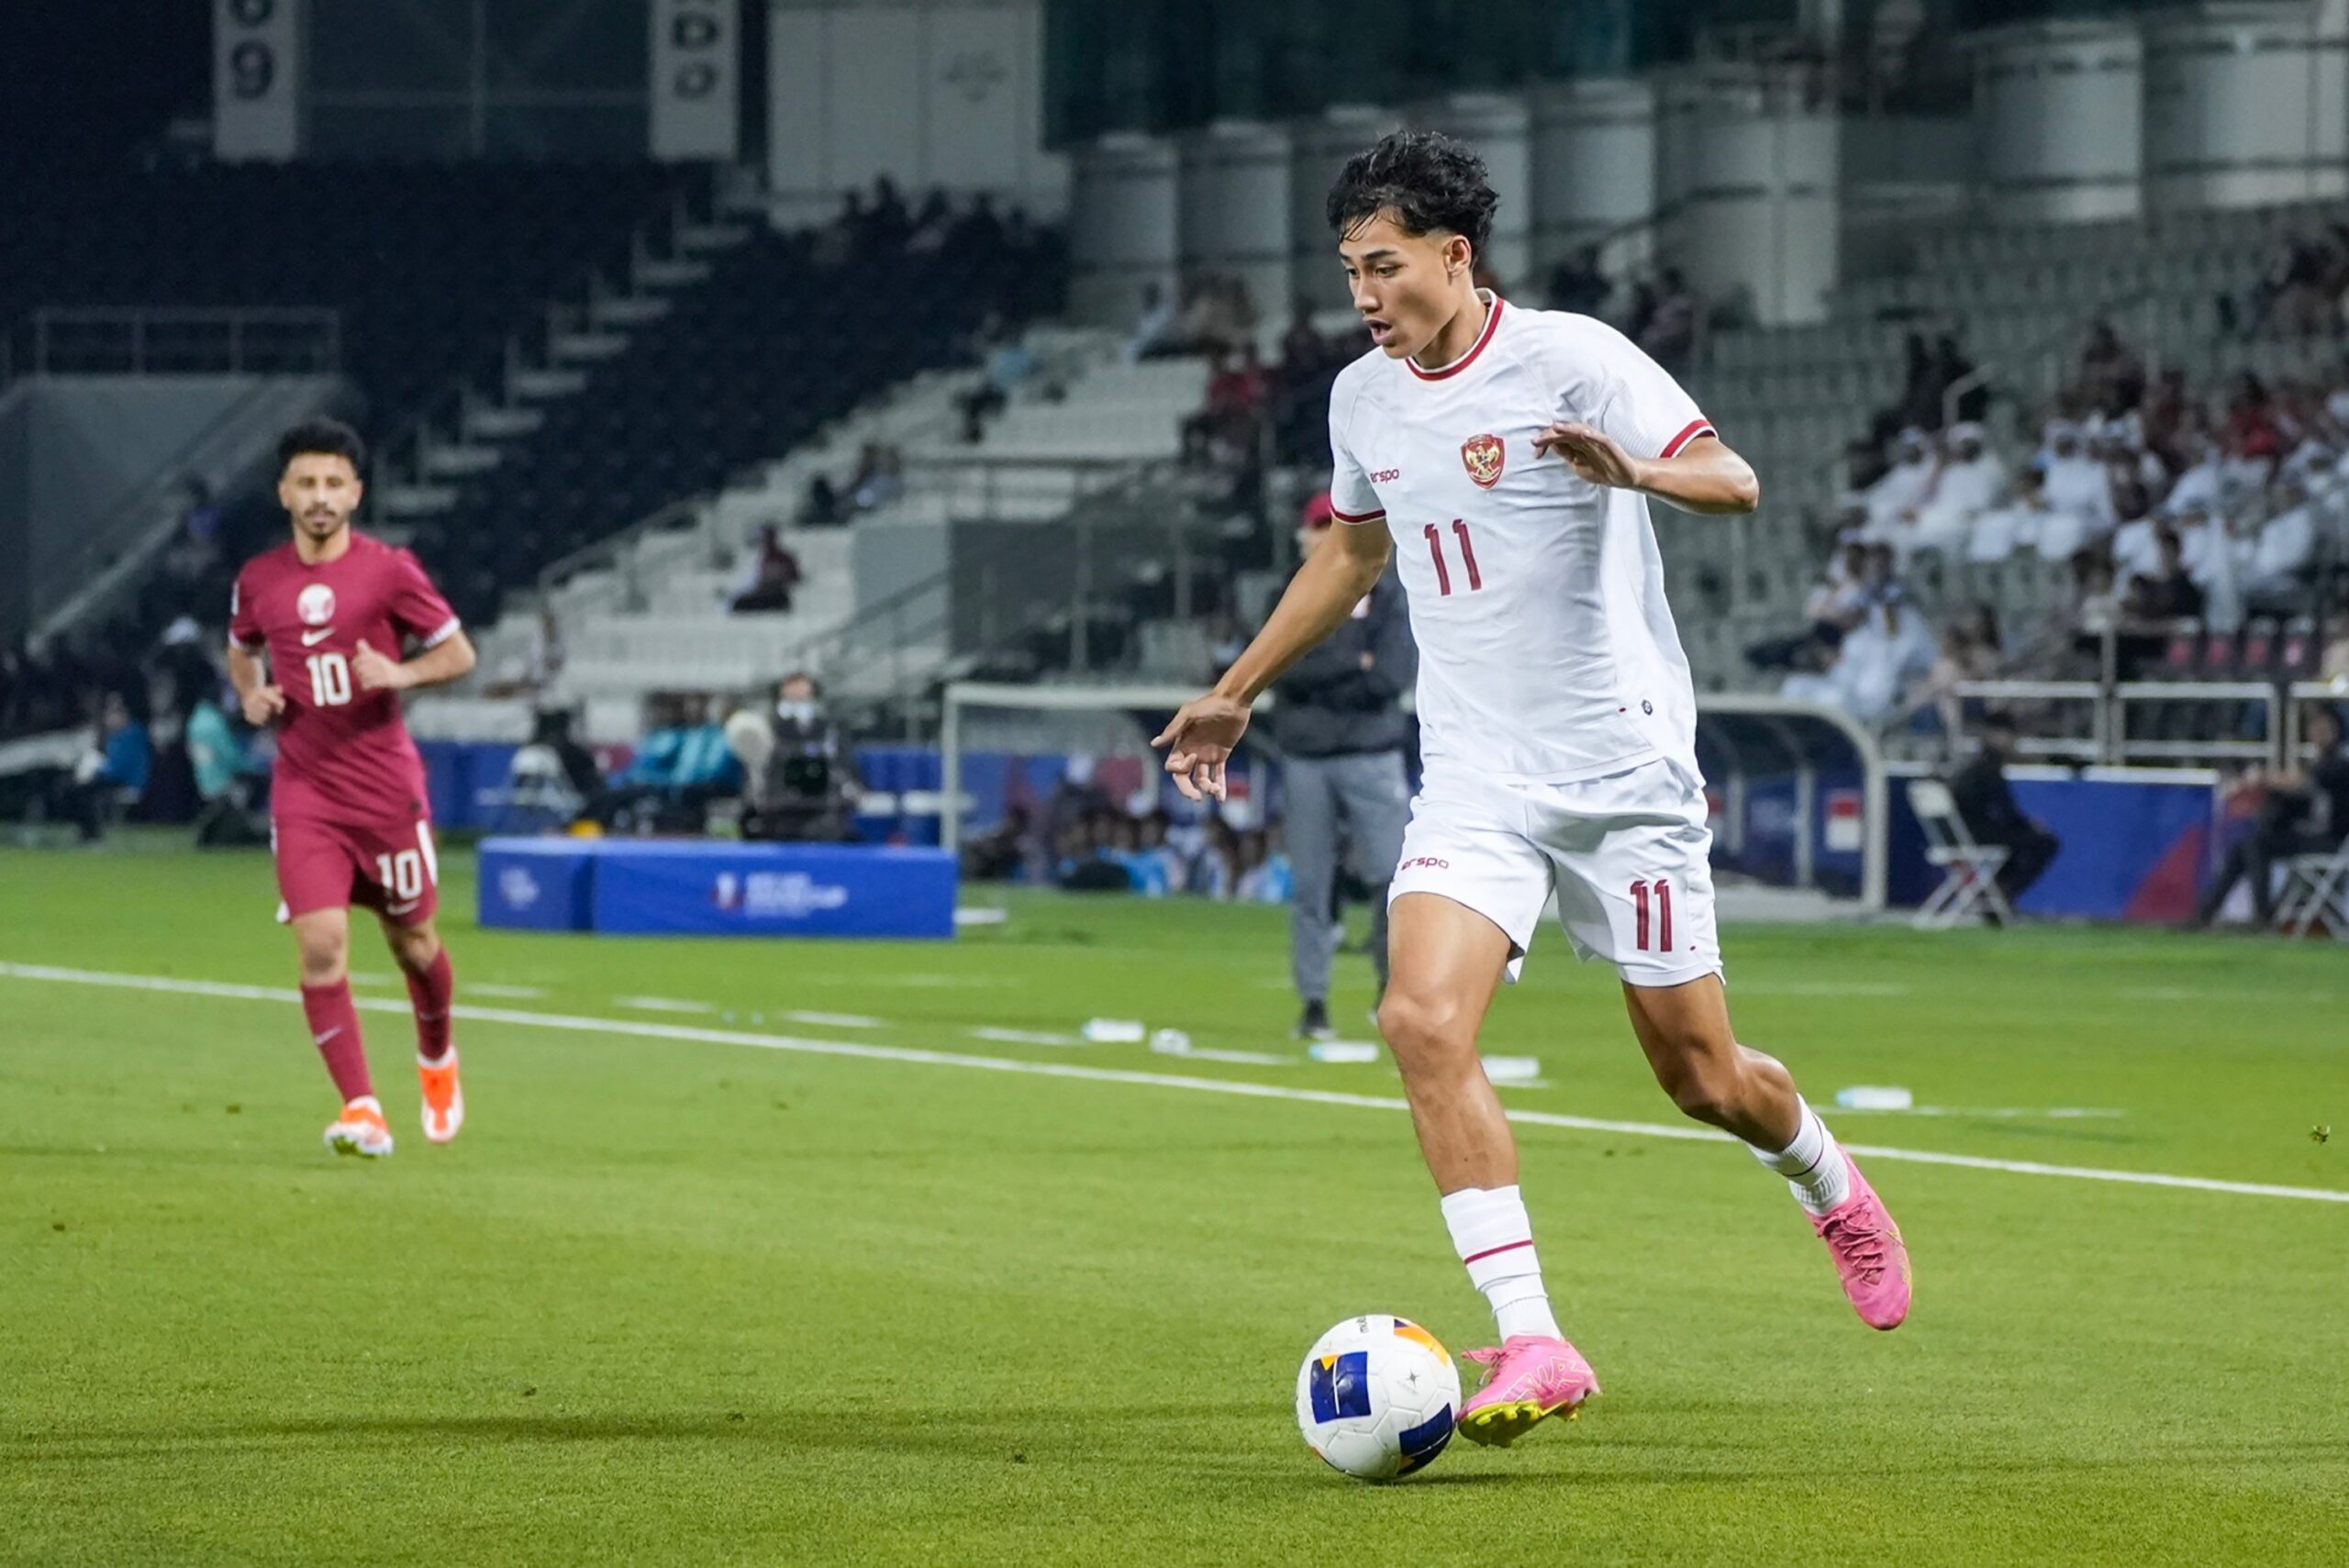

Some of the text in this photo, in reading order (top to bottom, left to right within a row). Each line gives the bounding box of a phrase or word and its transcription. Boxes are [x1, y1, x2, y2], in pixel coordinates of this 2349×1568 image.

[1369, 468, 1399, 484] erspo
[1423, 518, 1482, 596] 11
[306, 652, 352, 706] 10
[375, 849, 422, 900] 10
[1400, 857, 1449, 871] erspo
[1630, 879, 1672, 951] 11
